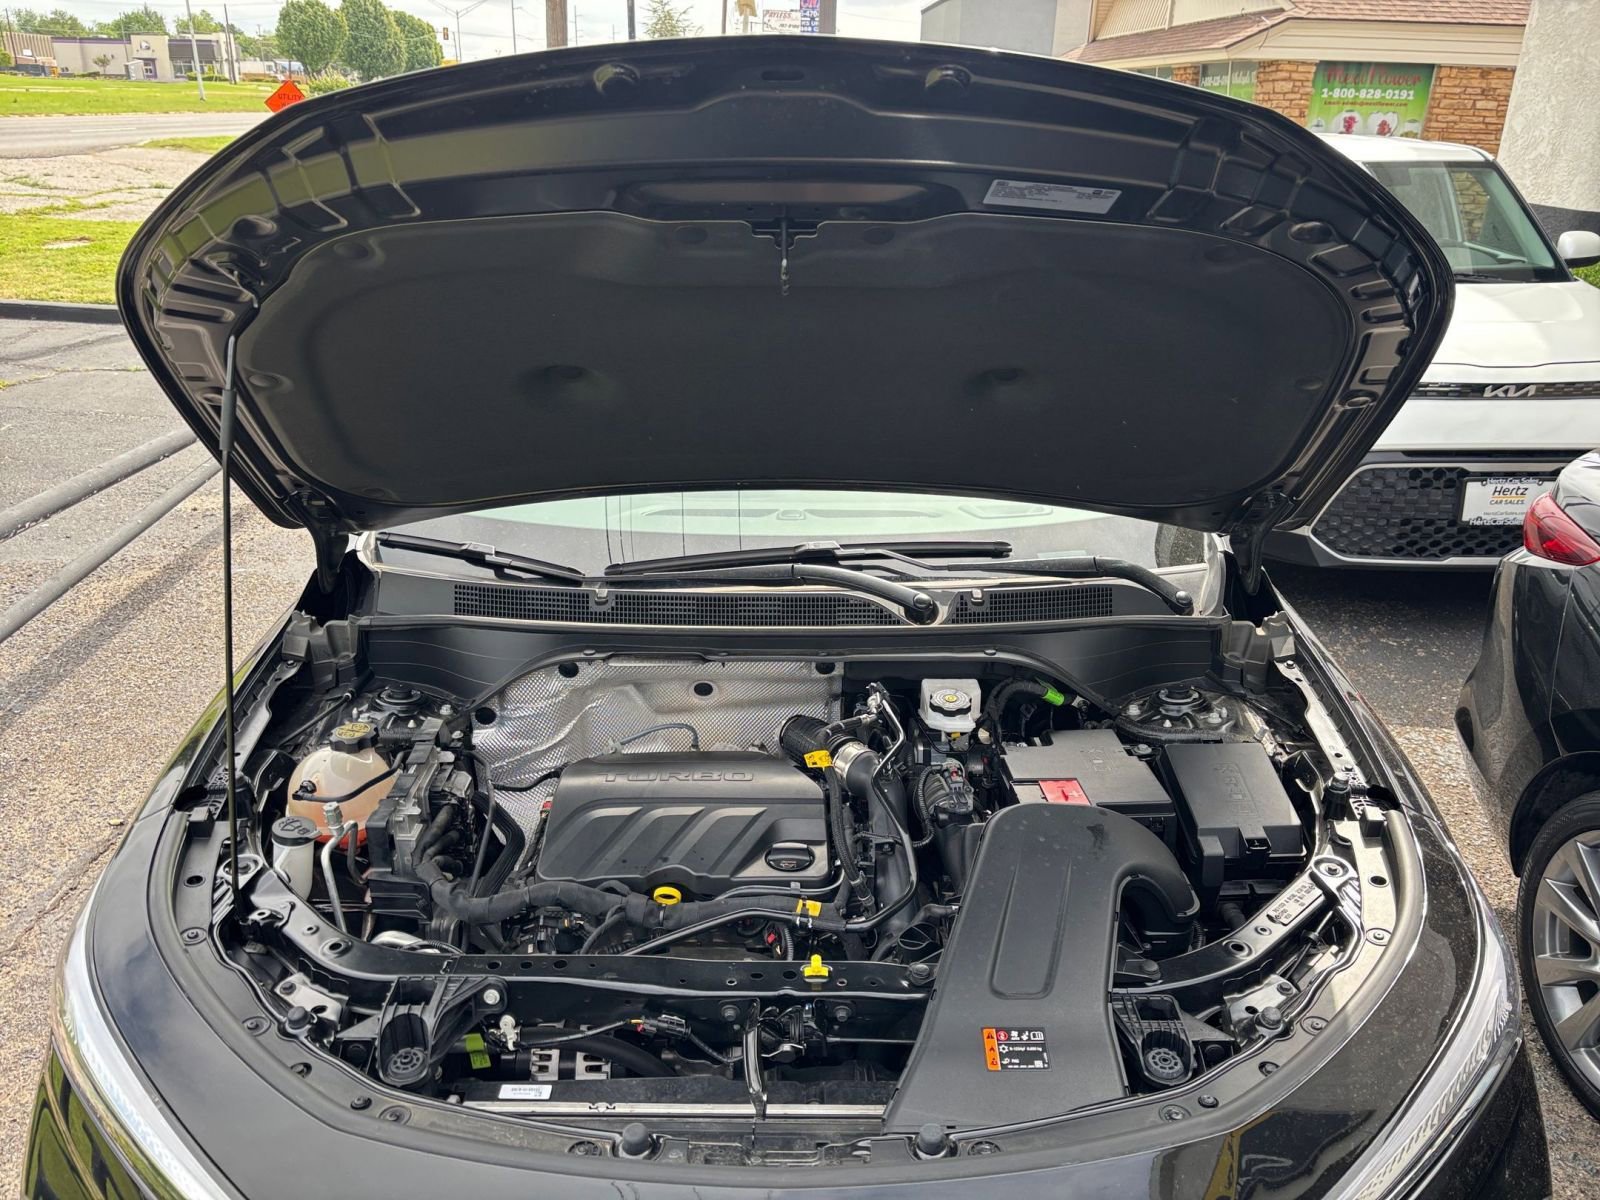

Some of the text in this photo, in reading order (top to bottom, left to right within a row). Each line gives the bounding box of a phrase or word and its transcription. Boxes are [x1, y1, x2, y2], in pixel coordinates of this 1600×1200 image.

[1321, 87, 1415, 100] 1-800-828-0191
[1483, 385, 1536, 397] KIA
[1487, 477, 1507, 485] Hertz
[1508, 477, 1518, 485] Car
[1492, 486, 1528, 496] Hertz
[597, 771, 755, 783] TURBO
